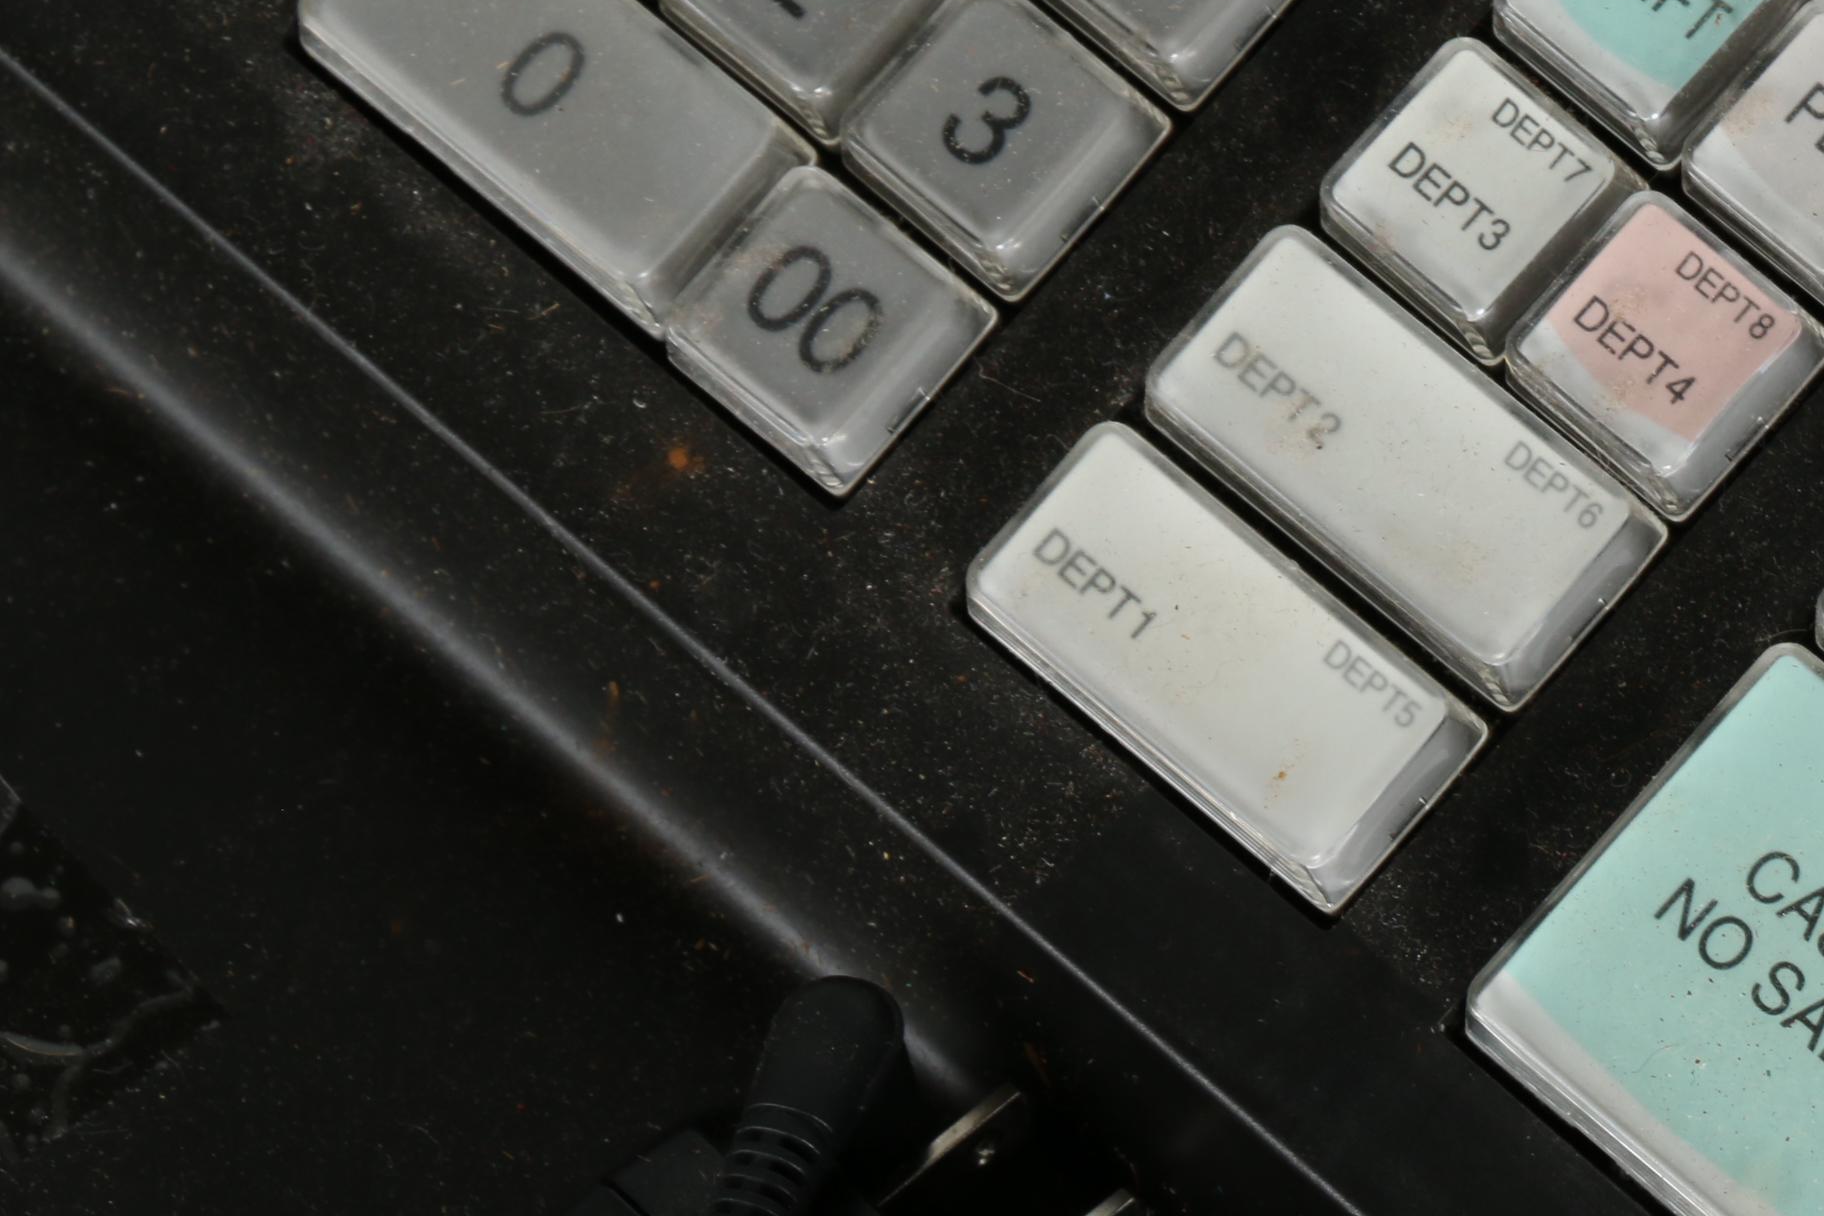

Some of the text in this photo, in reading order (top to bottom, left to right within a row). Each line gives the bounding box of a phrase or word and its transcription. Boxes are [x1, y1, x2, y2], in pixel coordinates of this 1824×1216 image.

[501, 32, 585, 117] 0
[941, 76, 1032, 165] 3
[1490, 98, 1596, 185] DEPT7
[1388, 141, 1512, 253] DEPT3
[746, 245, 883, 375] 00
[1675, 251, 1778, 340] DEPT8
[1211, 331, 1342, 446] DEPT2
[1572, 295, 1697, 406] DEPT4
[1504, 440, 1604, 530] DEPT6
[1031, 528, 1159, 642] DEPT1
[1323, 639, 1423, 730] DEPT5
[1653, 877, 1754, 970] NO
